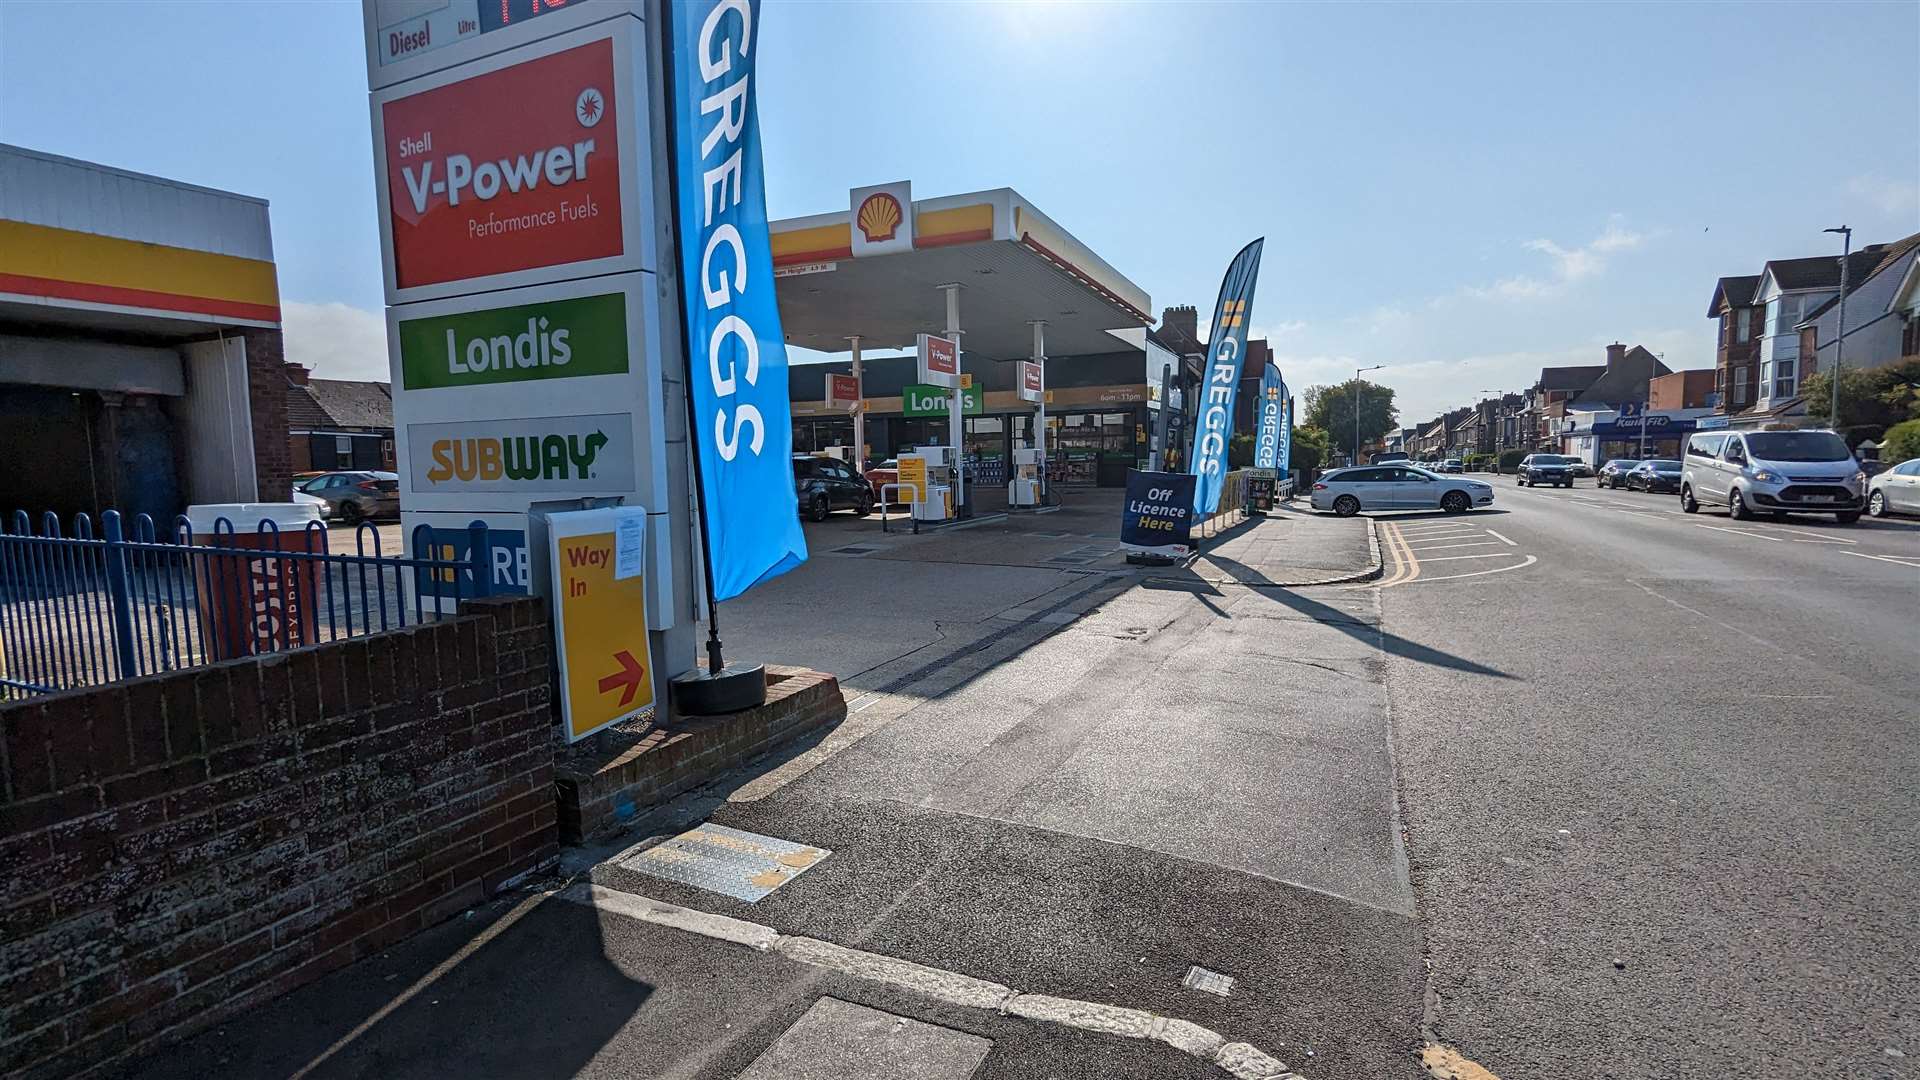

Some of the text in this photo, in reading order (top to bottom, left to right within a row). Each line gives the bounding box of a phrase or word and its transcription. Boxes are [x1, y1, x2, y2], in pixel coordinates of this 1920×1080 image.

[389, 18, 477, 57] Diesel Litre
[398, 131, 432, 159] Shell
[401, 136, 595, 215] V-Power
[468, 194, 599, 239] Performance Fuels
[697, 0, 765, 462] GREGGS
[446, 316, 572, 375] Londis
[911, 392, 974, 412] Lons
[1199, 336, 1239, 481] GREGGS
[427, 427, 609, 485] SUBWAY
[1129, 499, 1187, 518] Licence
[1147, 487, 1174, 502] Off
[1138, 515, 1174, 531] Here
[567, 544, 612, 570] Way
[570, 577, 587, 598] In
